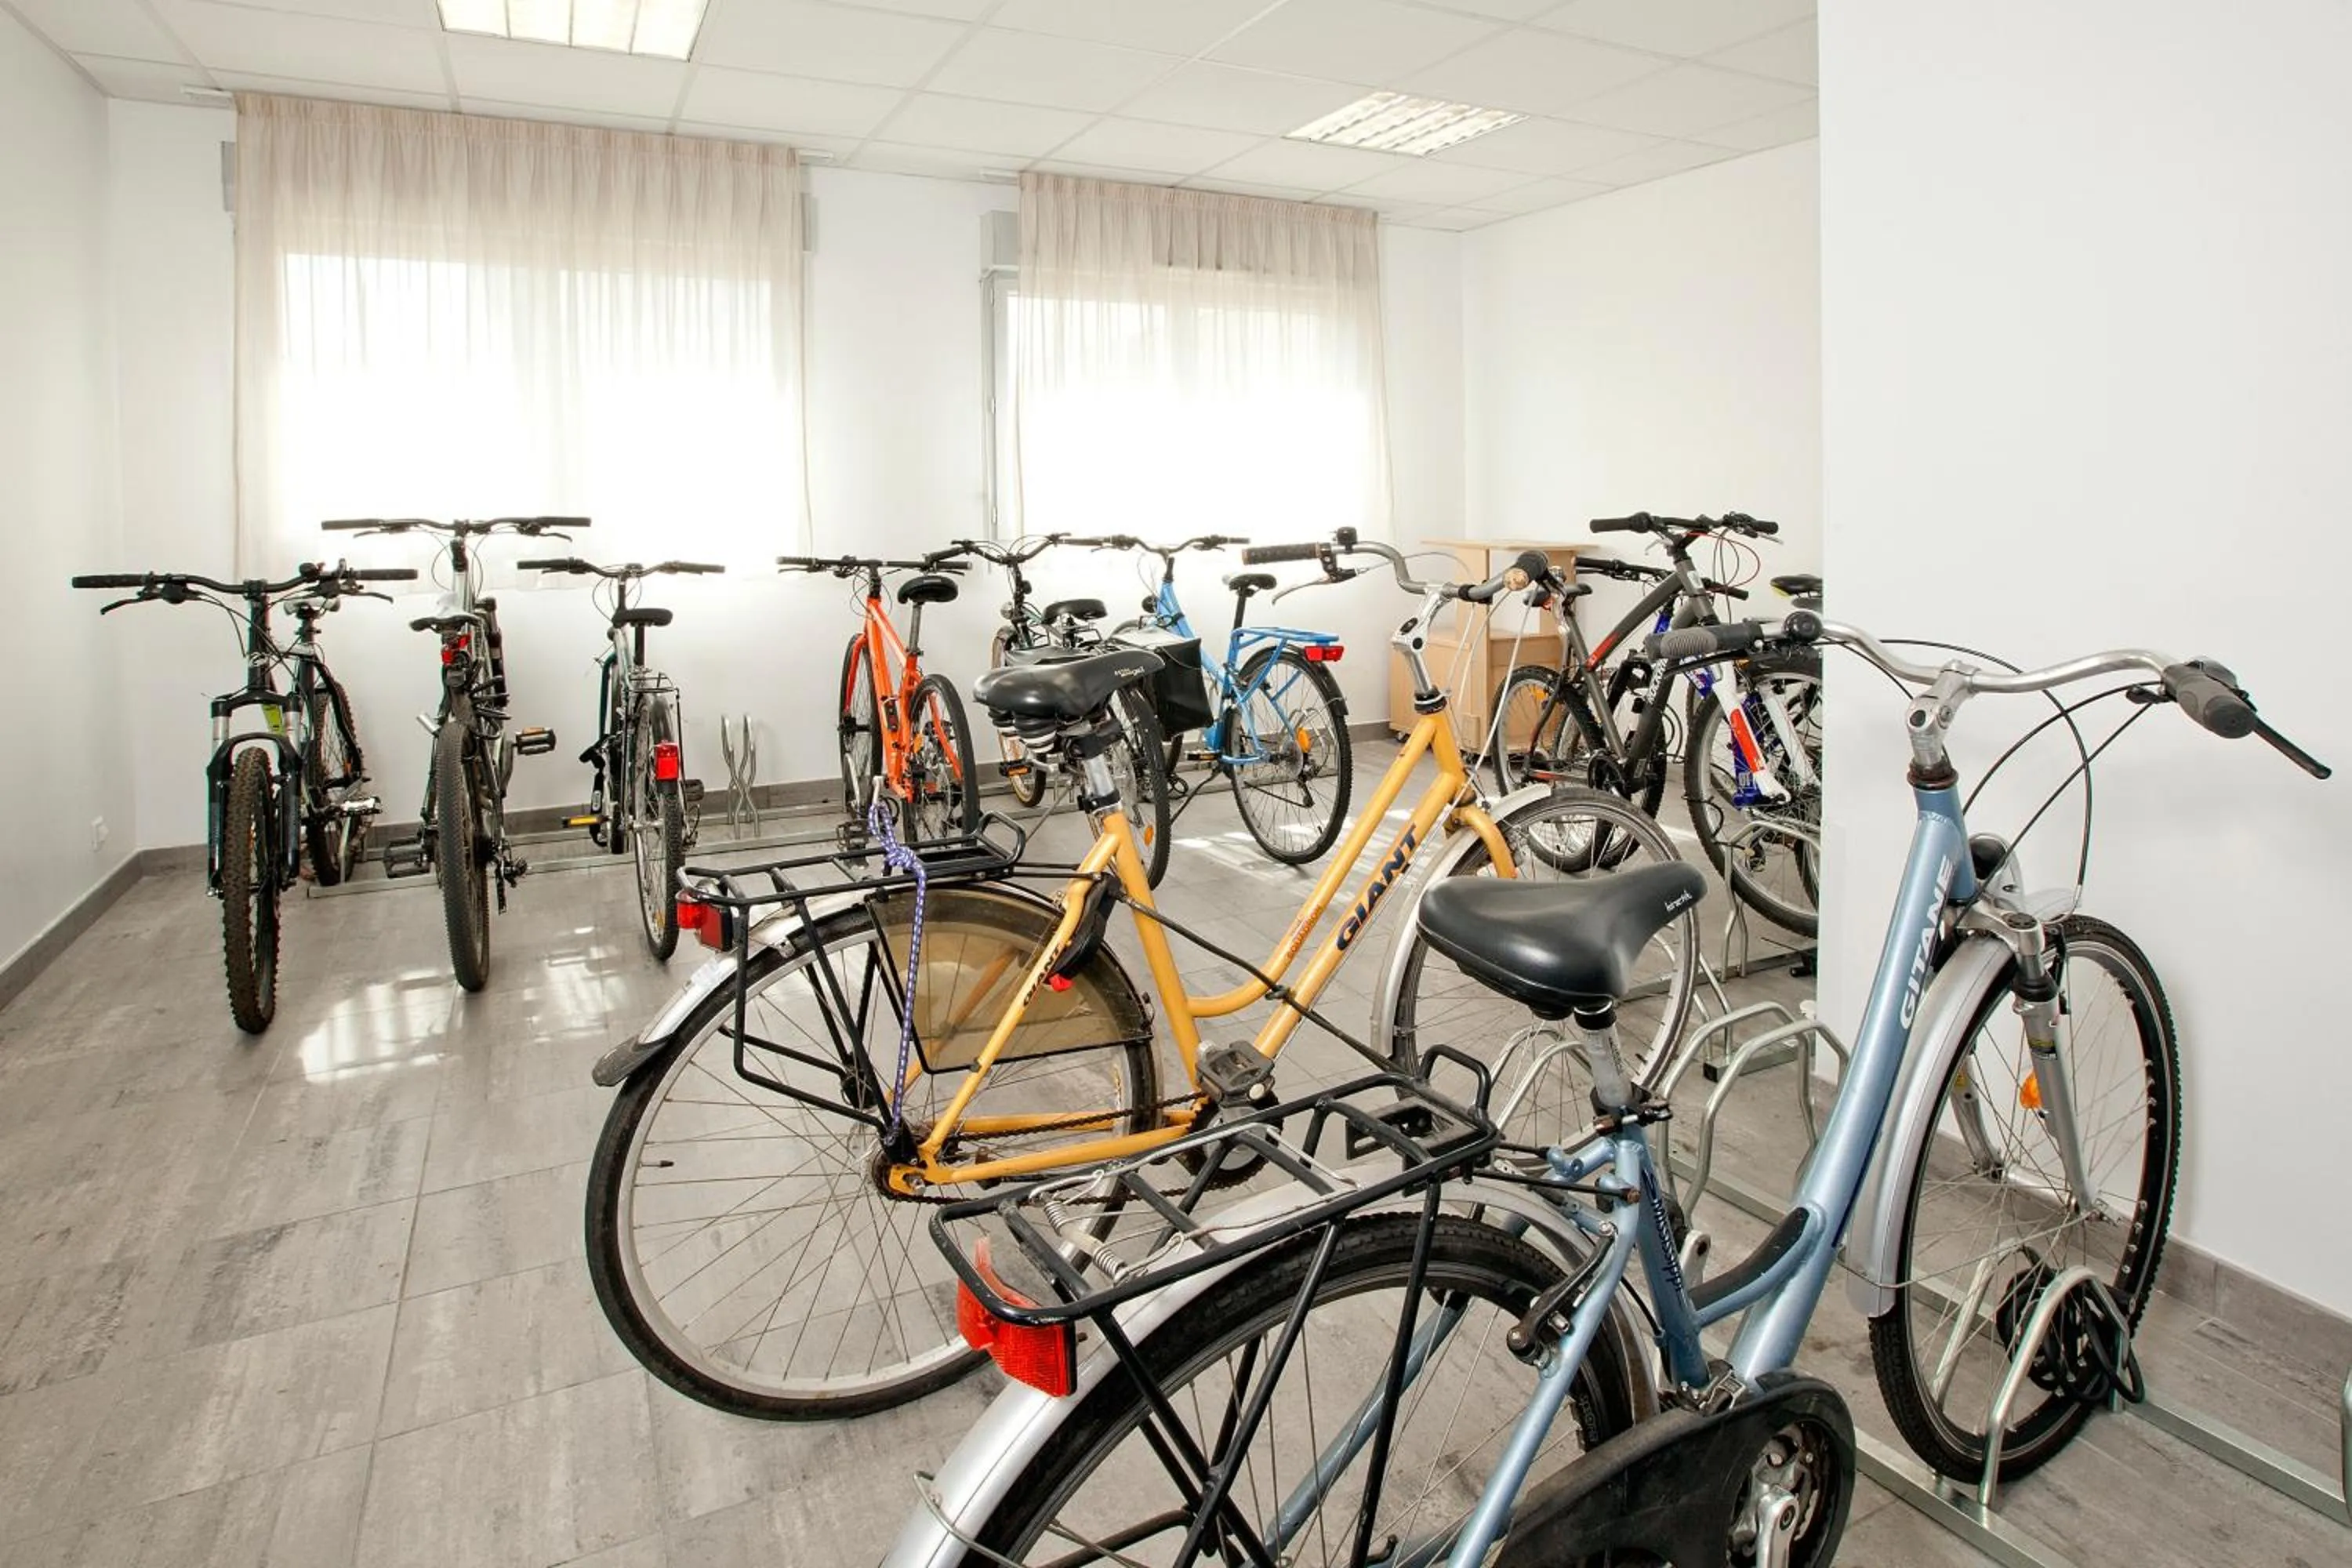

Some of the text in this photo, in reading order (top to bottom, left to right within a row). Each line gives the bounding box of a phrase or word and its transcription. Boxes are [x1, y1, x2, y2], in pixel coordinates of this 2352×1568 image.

[1336, 822, 1416, 951] GIANT
[1900, 854, 1955, 1029] GITANE
[1023, 943, 1060, 1007] GIANT
